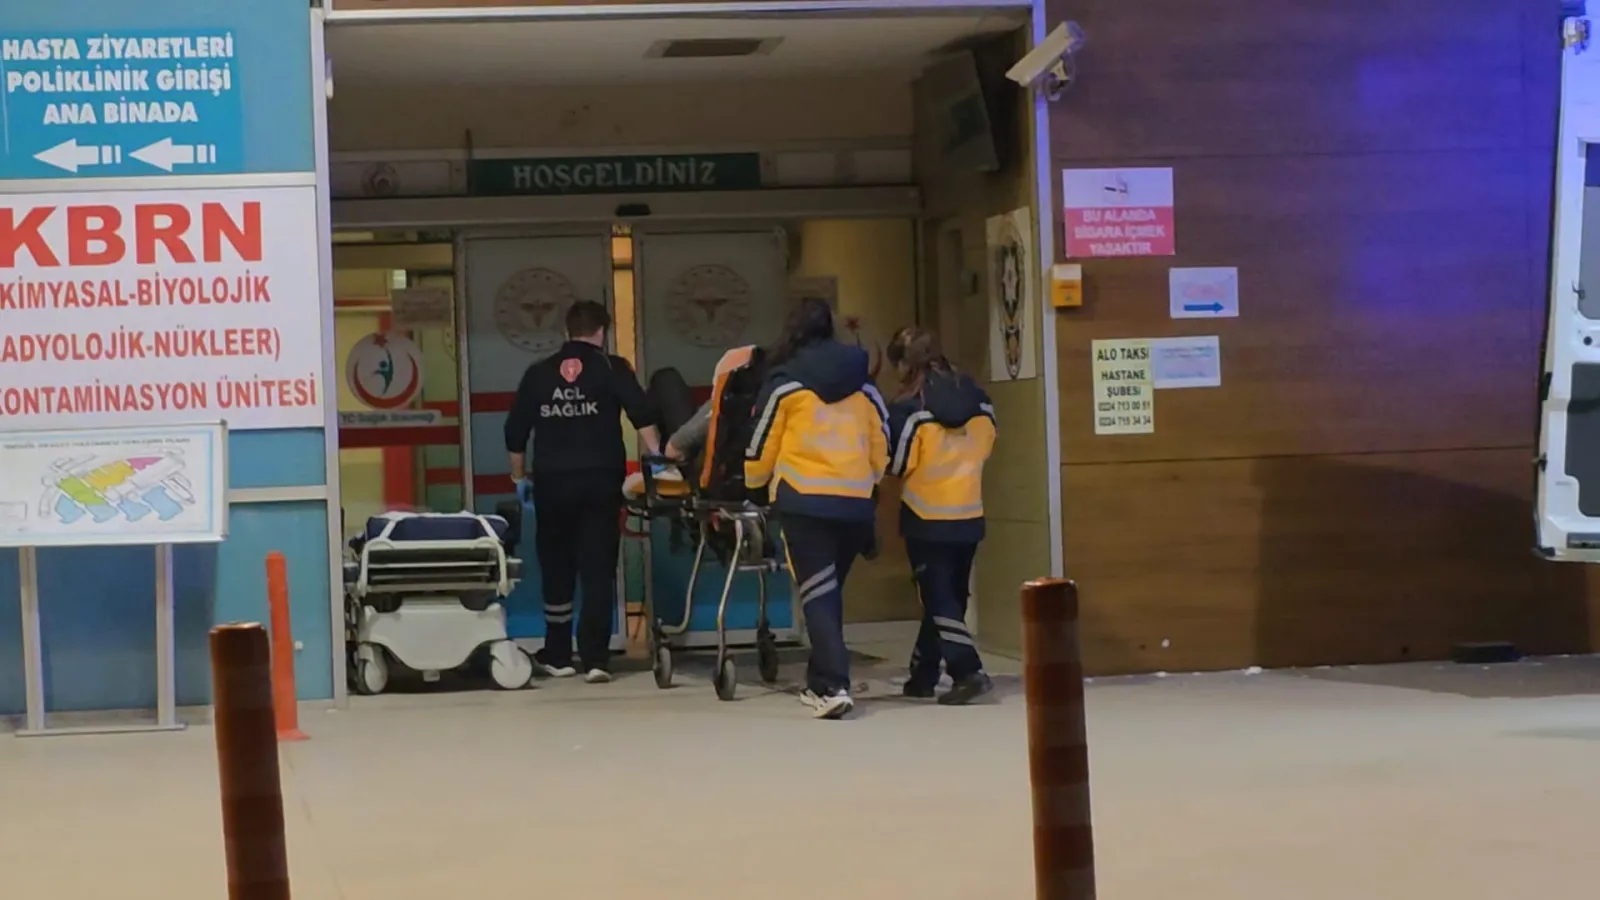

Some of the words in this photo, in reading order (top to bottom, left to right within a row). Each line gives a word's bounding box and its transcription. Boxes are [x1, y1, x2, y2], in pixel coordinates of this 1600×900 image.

[2, 38, 81, 60] HASTA
[86, 32, 234, 59] ZİYARETLERİ
[7, 64, 150, 93] POLİKLİNİK
[156, 62, 231, 96] GİRİŞİ
[43, 103, 97, 125] ANA
[104, 96, 199, 124] BİNADA
[512, 156, 716, 190] HOŞGELDİNİZ
[1082, 209, 1102, 222] BU
[0, 201, 262, 268] KBRN
[0, 269, 271, 310] KİMYASAL-BİYOLOJİK
[1097, 349, 1117, 361] ALO
[1101, 370, 1146, 380] HASTANE
[216, 372, 317, 409] ÜNİTESİ
[1107, 386, 1141, 398] ŞUBESİ
[540, 402, 598, 417] SAĞLIK
